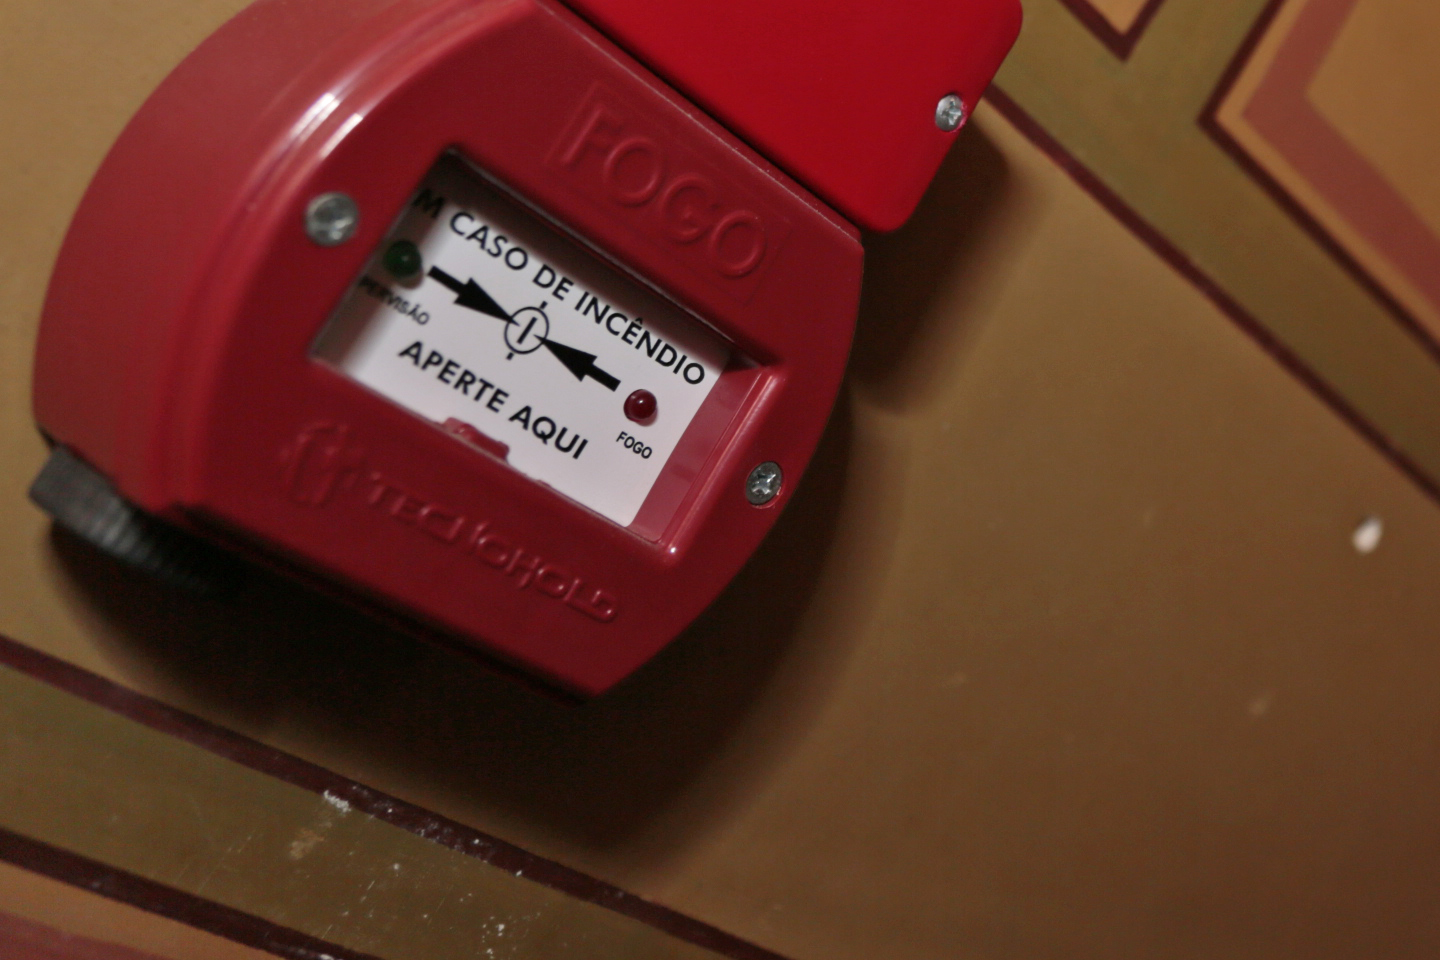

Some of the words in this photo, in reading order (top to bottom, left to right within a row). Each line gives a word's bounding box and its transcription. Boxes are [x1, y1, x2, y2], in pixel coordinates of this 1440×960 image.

[560, 101, 768, 281] FOGO
[450, 211, 529, 271] CASO
[533, 264, 575, 301] DE
[574, 291, 706, 386] INCÊNDIO
[398, 340, 510, 414] APERTE
[509, 405, 589, 461] AQUI
[615, 431, 654, 460] FOGO
